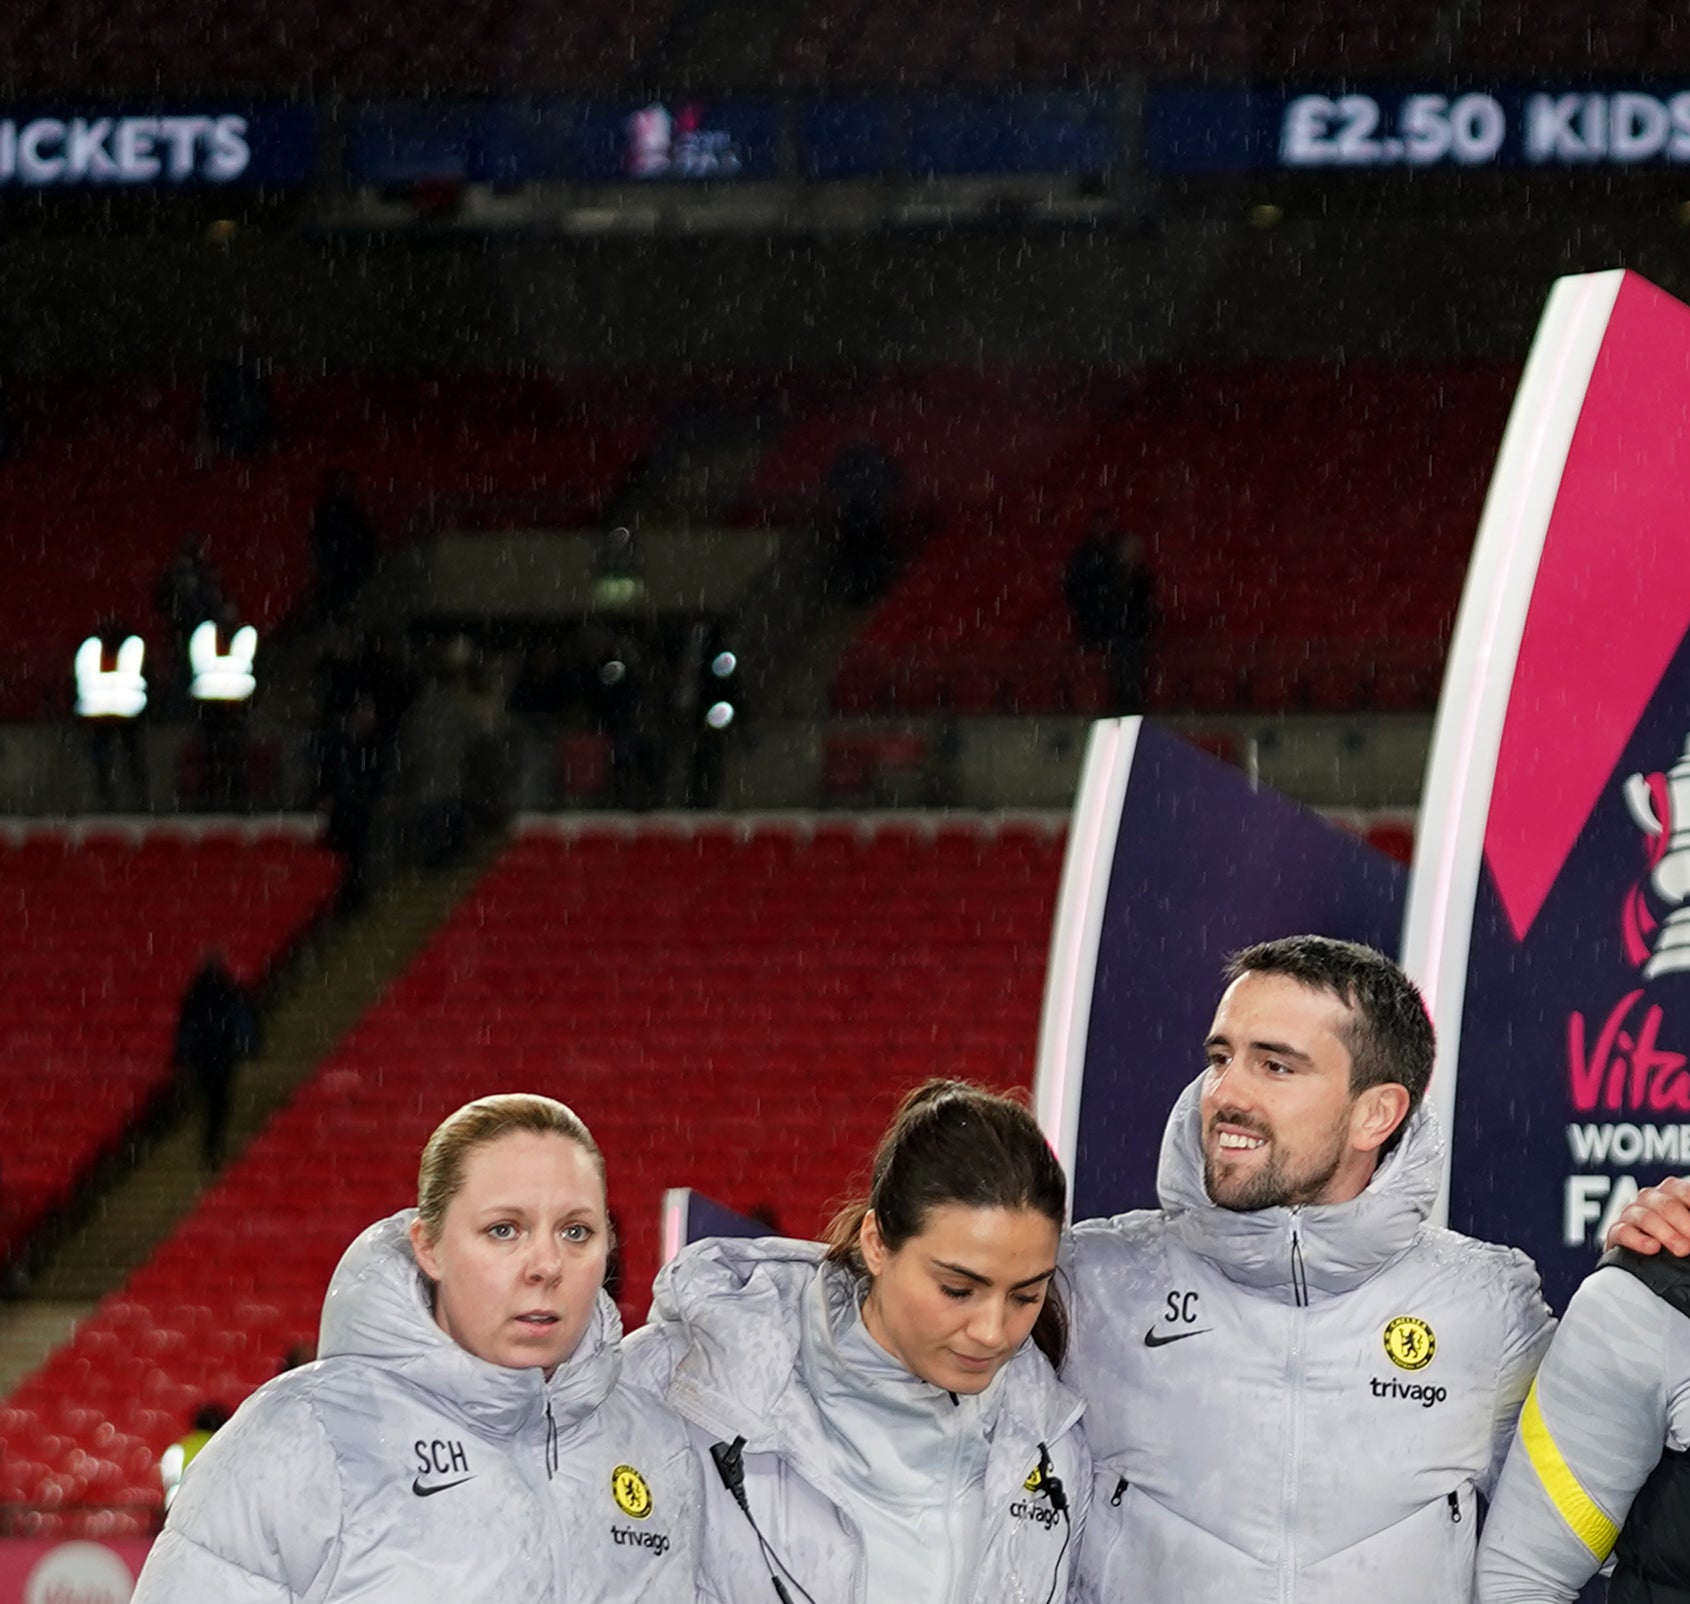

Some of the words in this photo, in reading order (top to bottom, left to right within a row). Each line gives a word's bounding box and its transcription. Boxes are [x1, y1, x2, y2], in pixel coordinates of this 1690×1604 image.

[1281, 94, 1506, 164] £2.50
[1164, 1290, 1198, 1324] SC
[1369, 1377, 1448, 1409] trivago
[414, 1439, 469, 1475] SCH
[610, 1525, 670, 1556] trivago
